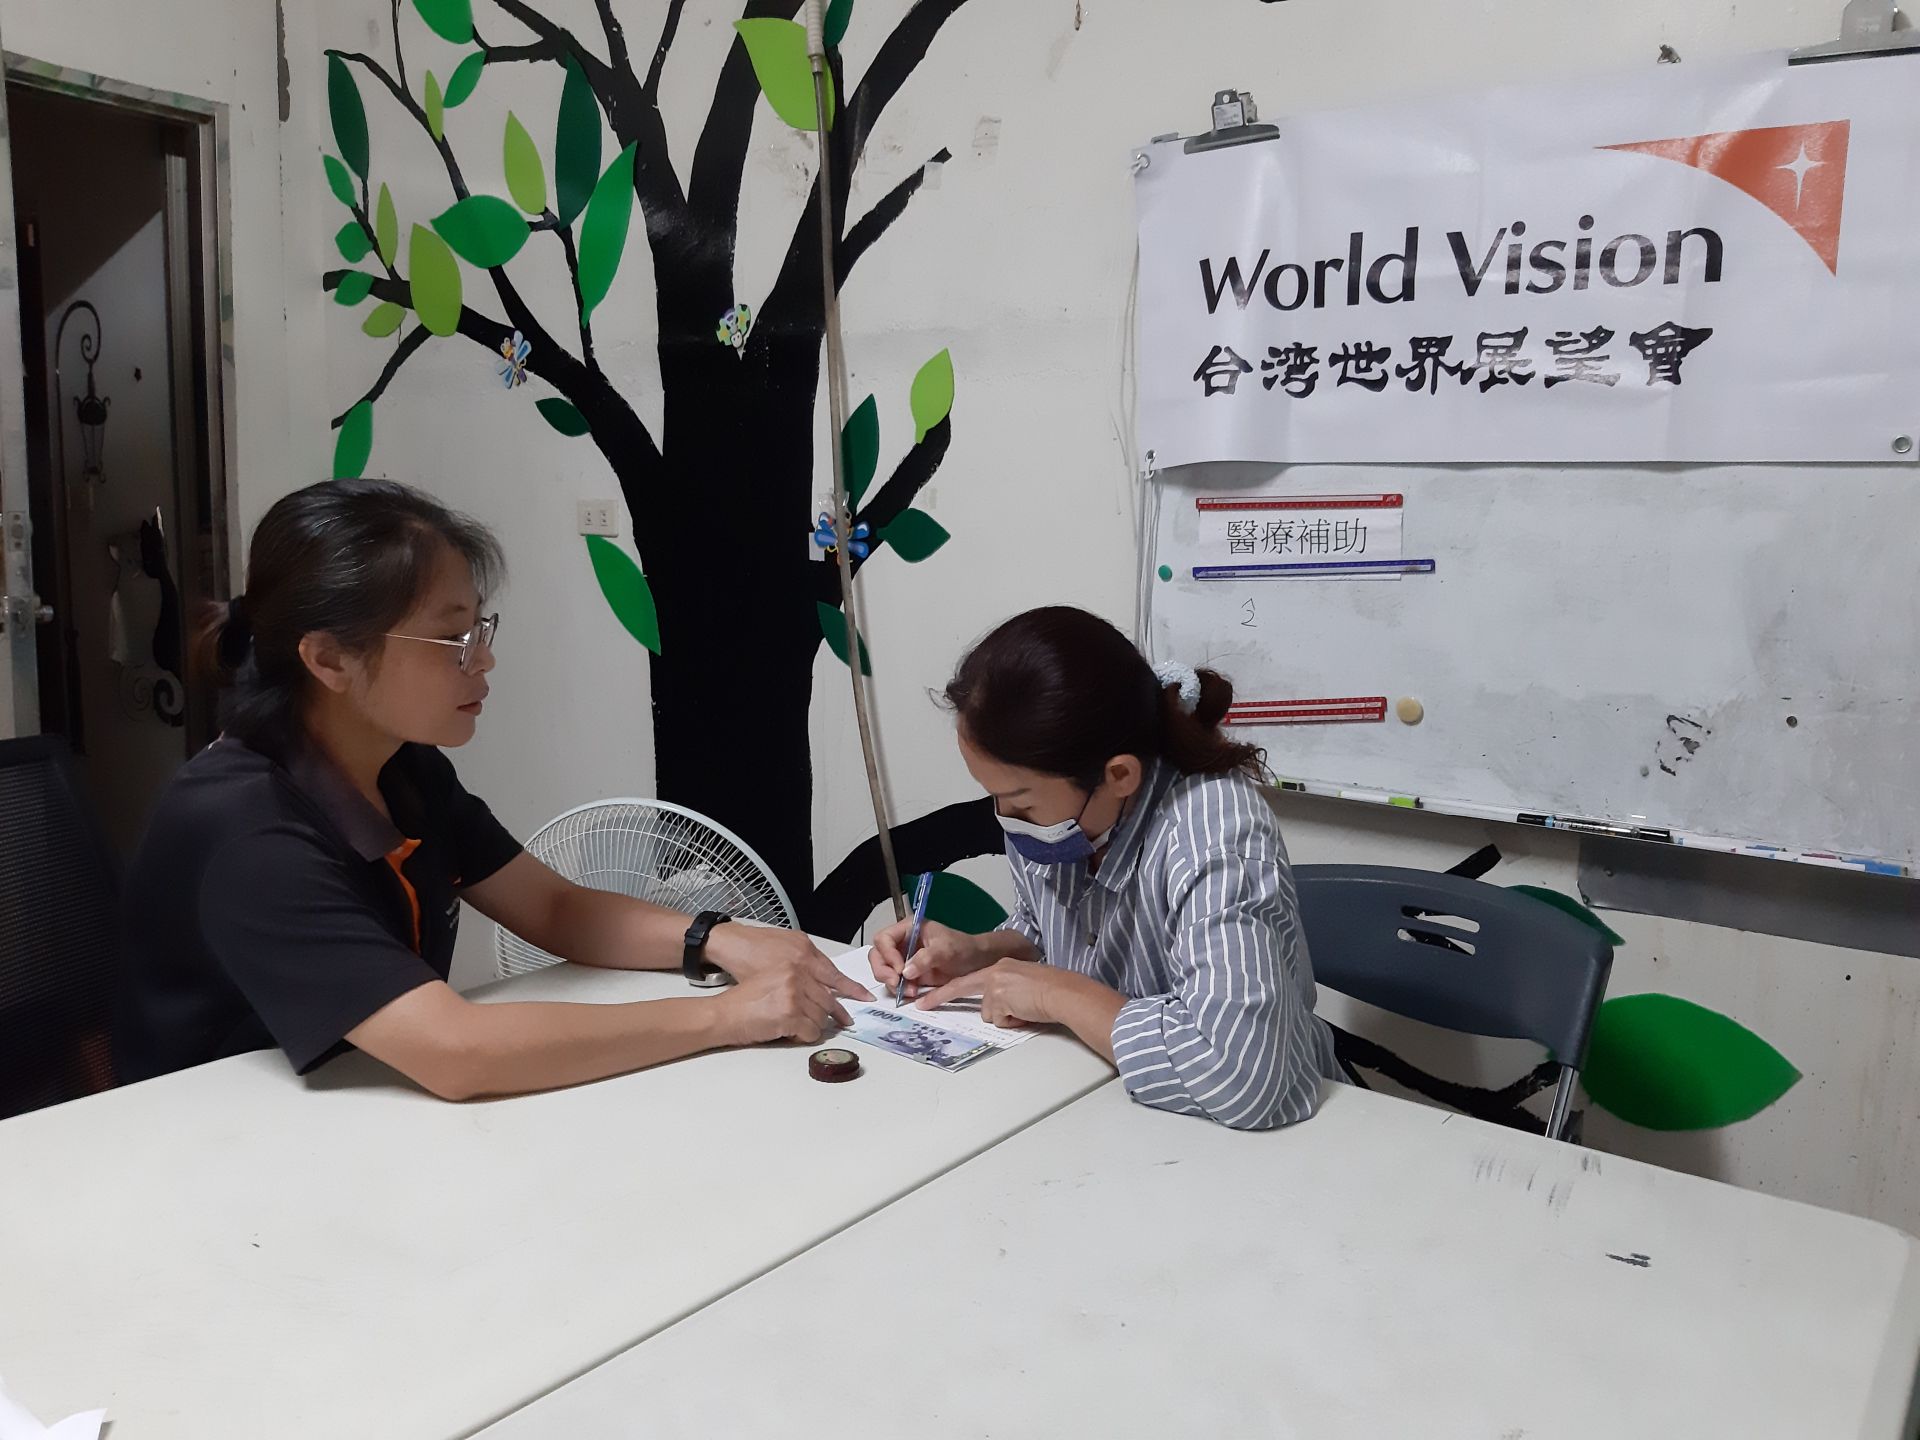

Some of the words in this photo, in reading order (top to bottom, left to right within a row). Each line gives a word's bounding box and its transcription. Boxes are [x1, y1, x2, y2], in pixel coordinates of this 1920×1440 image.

[1199, 226, 1419, 315] World
[1446, 214, 1724, 297] Vision
[1226, 517, 1368, 555] 醫療補助
[866, 1009, 903, 1023] 1000
